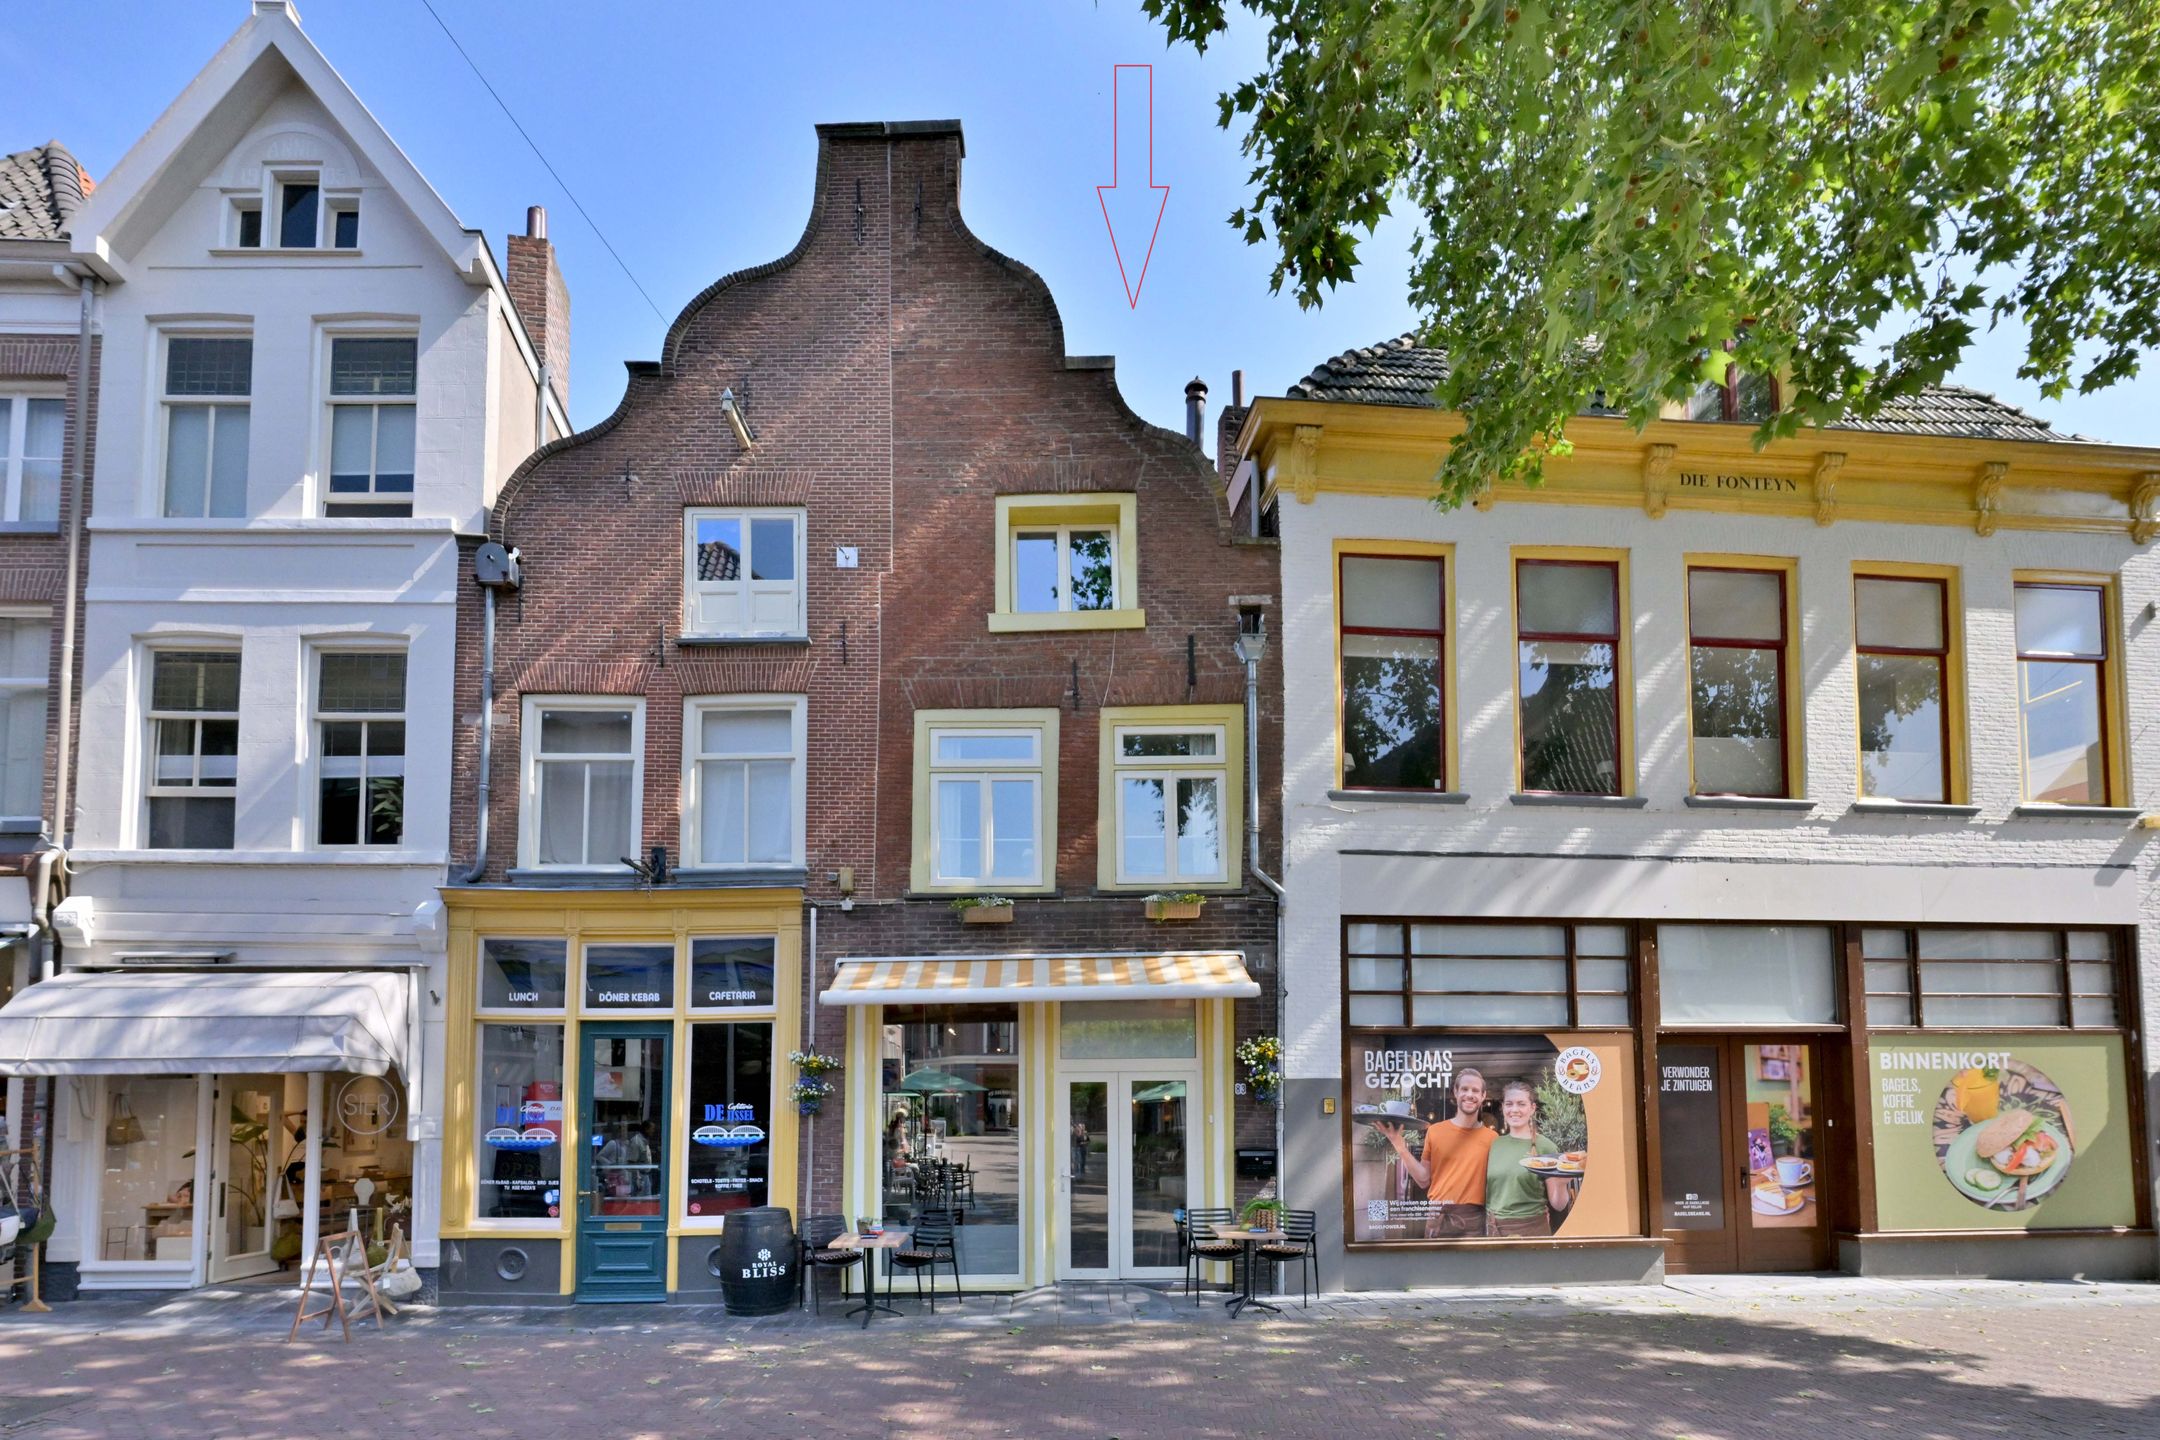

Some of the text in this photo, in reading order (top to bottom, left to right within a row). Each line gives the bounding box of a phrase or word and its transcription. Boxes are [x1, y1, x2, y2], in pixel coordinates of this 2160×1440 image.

[1680, 473, 1796, 491] DIE FONTEYN
[508, 992, 538, 1001] LUNCH
[599, 991, 660, 1002] DÖNER KEBAB
[709, 991, 756, 1000] CAFETARIA
[1364, 1050, 1453, 1072] BAGELBAAS
[1880, 1052, 2011, 1070] BINNENKORT
[1662, 1066, 1710, 1078] VERWONDER
[1365, 1072, 1453, 1089] GEZOCHT
[1661, 1079, 1713, 1092] JE ZINTUIGEN
[1881, 1078, 1921, 1094] BAGELS,
[1235, 1083, 1246, 1095] 83
[344, 1093, 391, 1115] SIER
[1882, 1094, 1914, 1109] KOFFIE
[704, 1104, 724, 1121] DE
[1894, 1110, 1924, 1125] GELUK
[742, 1265, 786, 1278] BLISS
